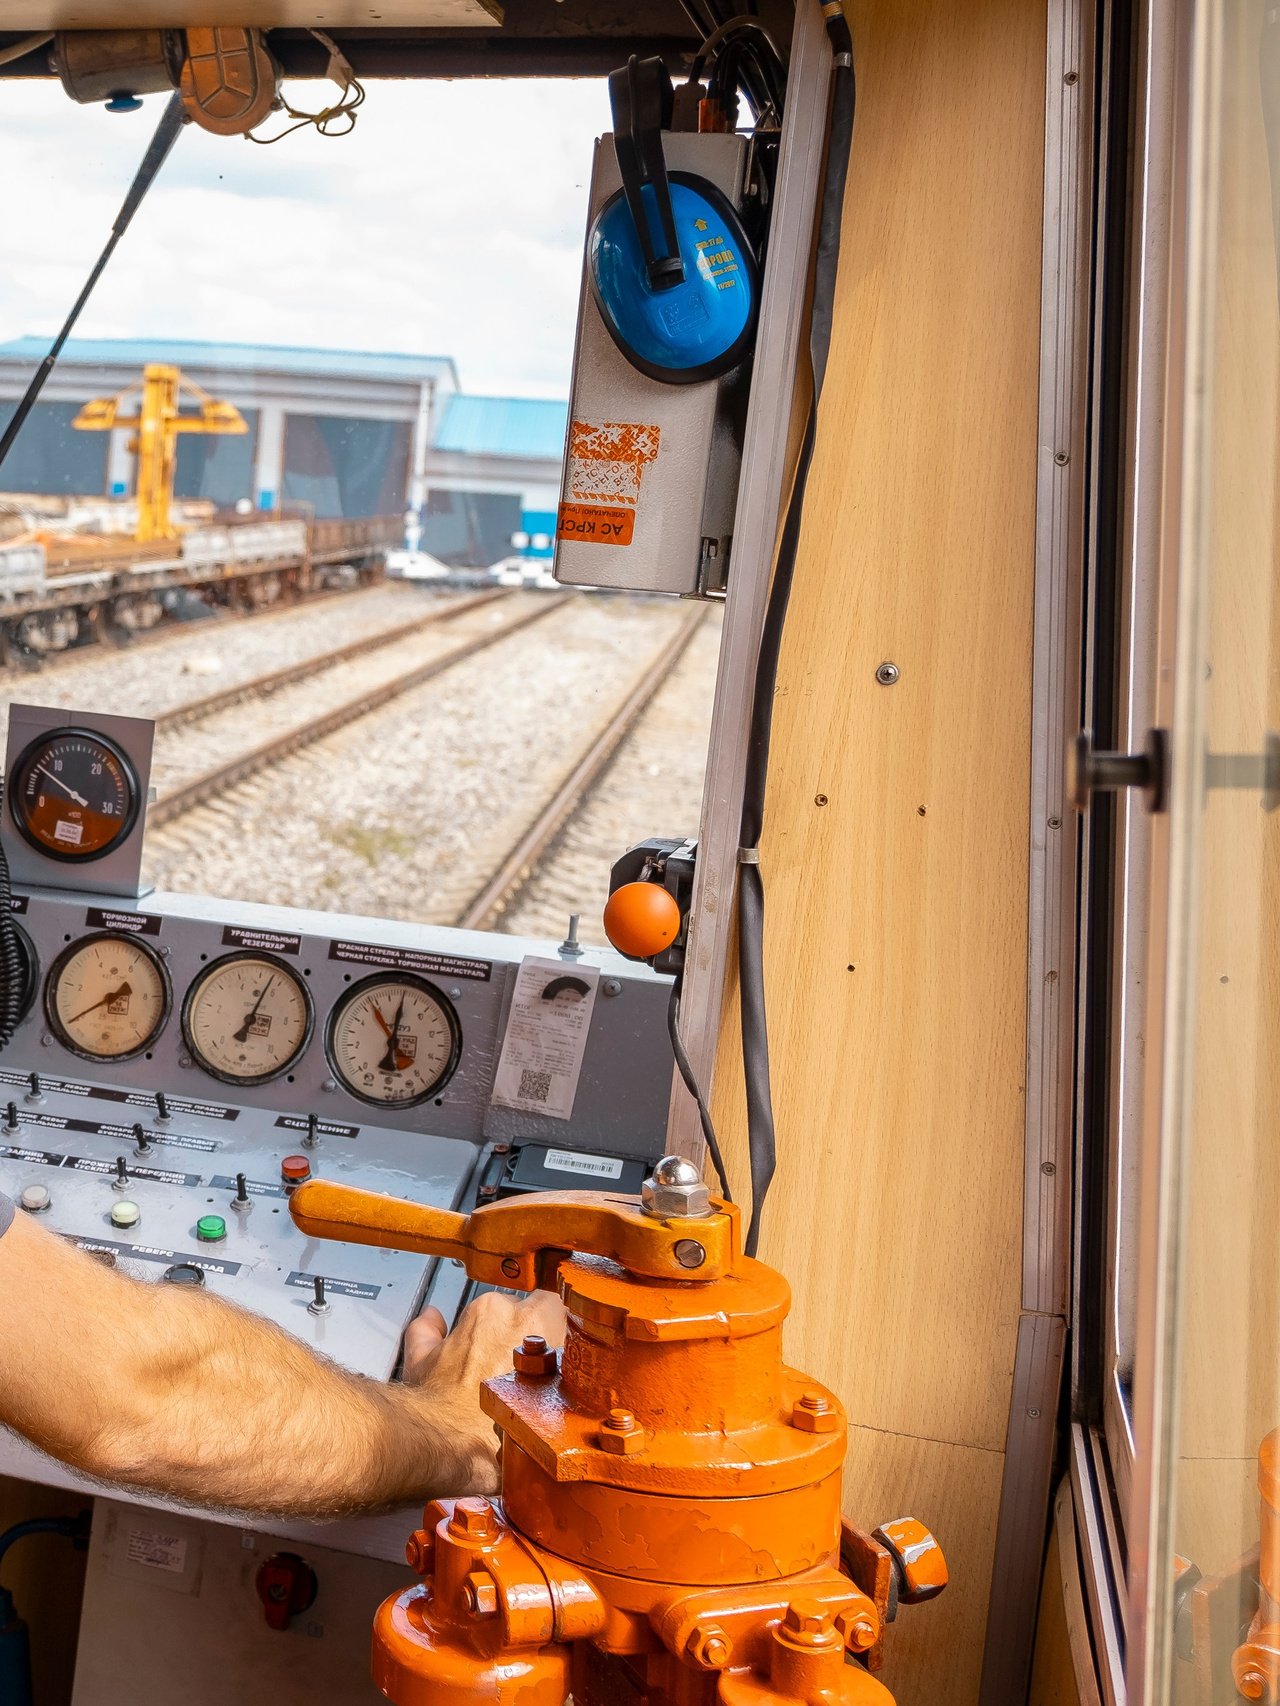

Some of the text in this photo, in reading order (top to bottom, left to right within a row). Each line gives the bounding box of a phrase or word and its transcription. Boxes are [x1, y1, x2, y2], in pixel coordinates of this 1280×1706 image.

[601, 523, 624, 536] АС
[54, 760, 63, 771] 10
[91, 763, 102, 775] 20
[39, 795, 45, 807] 0
[102, 801, 113, 814] 30
[101, 911, 147, 925] ТОРМОЗНОЙ
[105, 921, 143, 932] ЦИЛИНДР
[230, 929, 299, 945] УРАВНИТЕЛЬНЫЙ
[241, 938, 286, 950] РЕЗЕРВУАР
[337, 943, 489, 970] КРАСНАЯ СТРЕЛКА НАПОРНАЯ МАГИСТРАЛЬ
[128, 965, 133, 973] 6
[336, 950, 364, 961] ЧЕРНАЯ
[397, 959, 439, 972] ТОРМОЗНАЯ
[439, 965, 486, 978] МАГИСТРАЛЬ
[240, 983, 244, 991] 4
[143, 993, 148, 1001] 8
[270, 988, 275, 998] 6
[216, 1004, 221, 1014] 2
[283, 1016, 288, 1025] 8
[418, 1013, 424, 1021] 10
[130, 1021, 137, 1029] 10
[220, 1035, 225, 1045] 0
[428, 1031, 435, 1039] 12
[268, 1044, 274, 1054] 10
[355, 1041, 360, 1049] 2
[363, 1062, 368, 1070] 0
[414, 1069, 420, 1078] 16
[64, 1083, 92, 1092] ЛЕВЫЕ
[169, 1106, 225, 1118] СИГНАЛЬНЫЙ
[193, 1104, 228, 1114] ПРАВЫЕ
[40, 1115, 69, 1124] ЛЕВЫЕ
[100, 1125, 134, 1134] ФОНАРИ
[180, 1137, 216, 1147] ПРАВЫЕ
[156, 1138, 213, 1151] СИГНАЛЬНЫЙ
[7, 1147, 44, 1158] ЗАДНИЙ
[23, 1155, 49, 1164] ЯРКО
[74, 1163, 185, 1185] ТУСКЛО ЯРКО
[135, 1167, 186, 1180] ПЕРЕДНИЙ
[131, 1245, 175, 1257] РЕВЕРС
[344, 1288, 375, 1297] ЗАДНЯЯ
